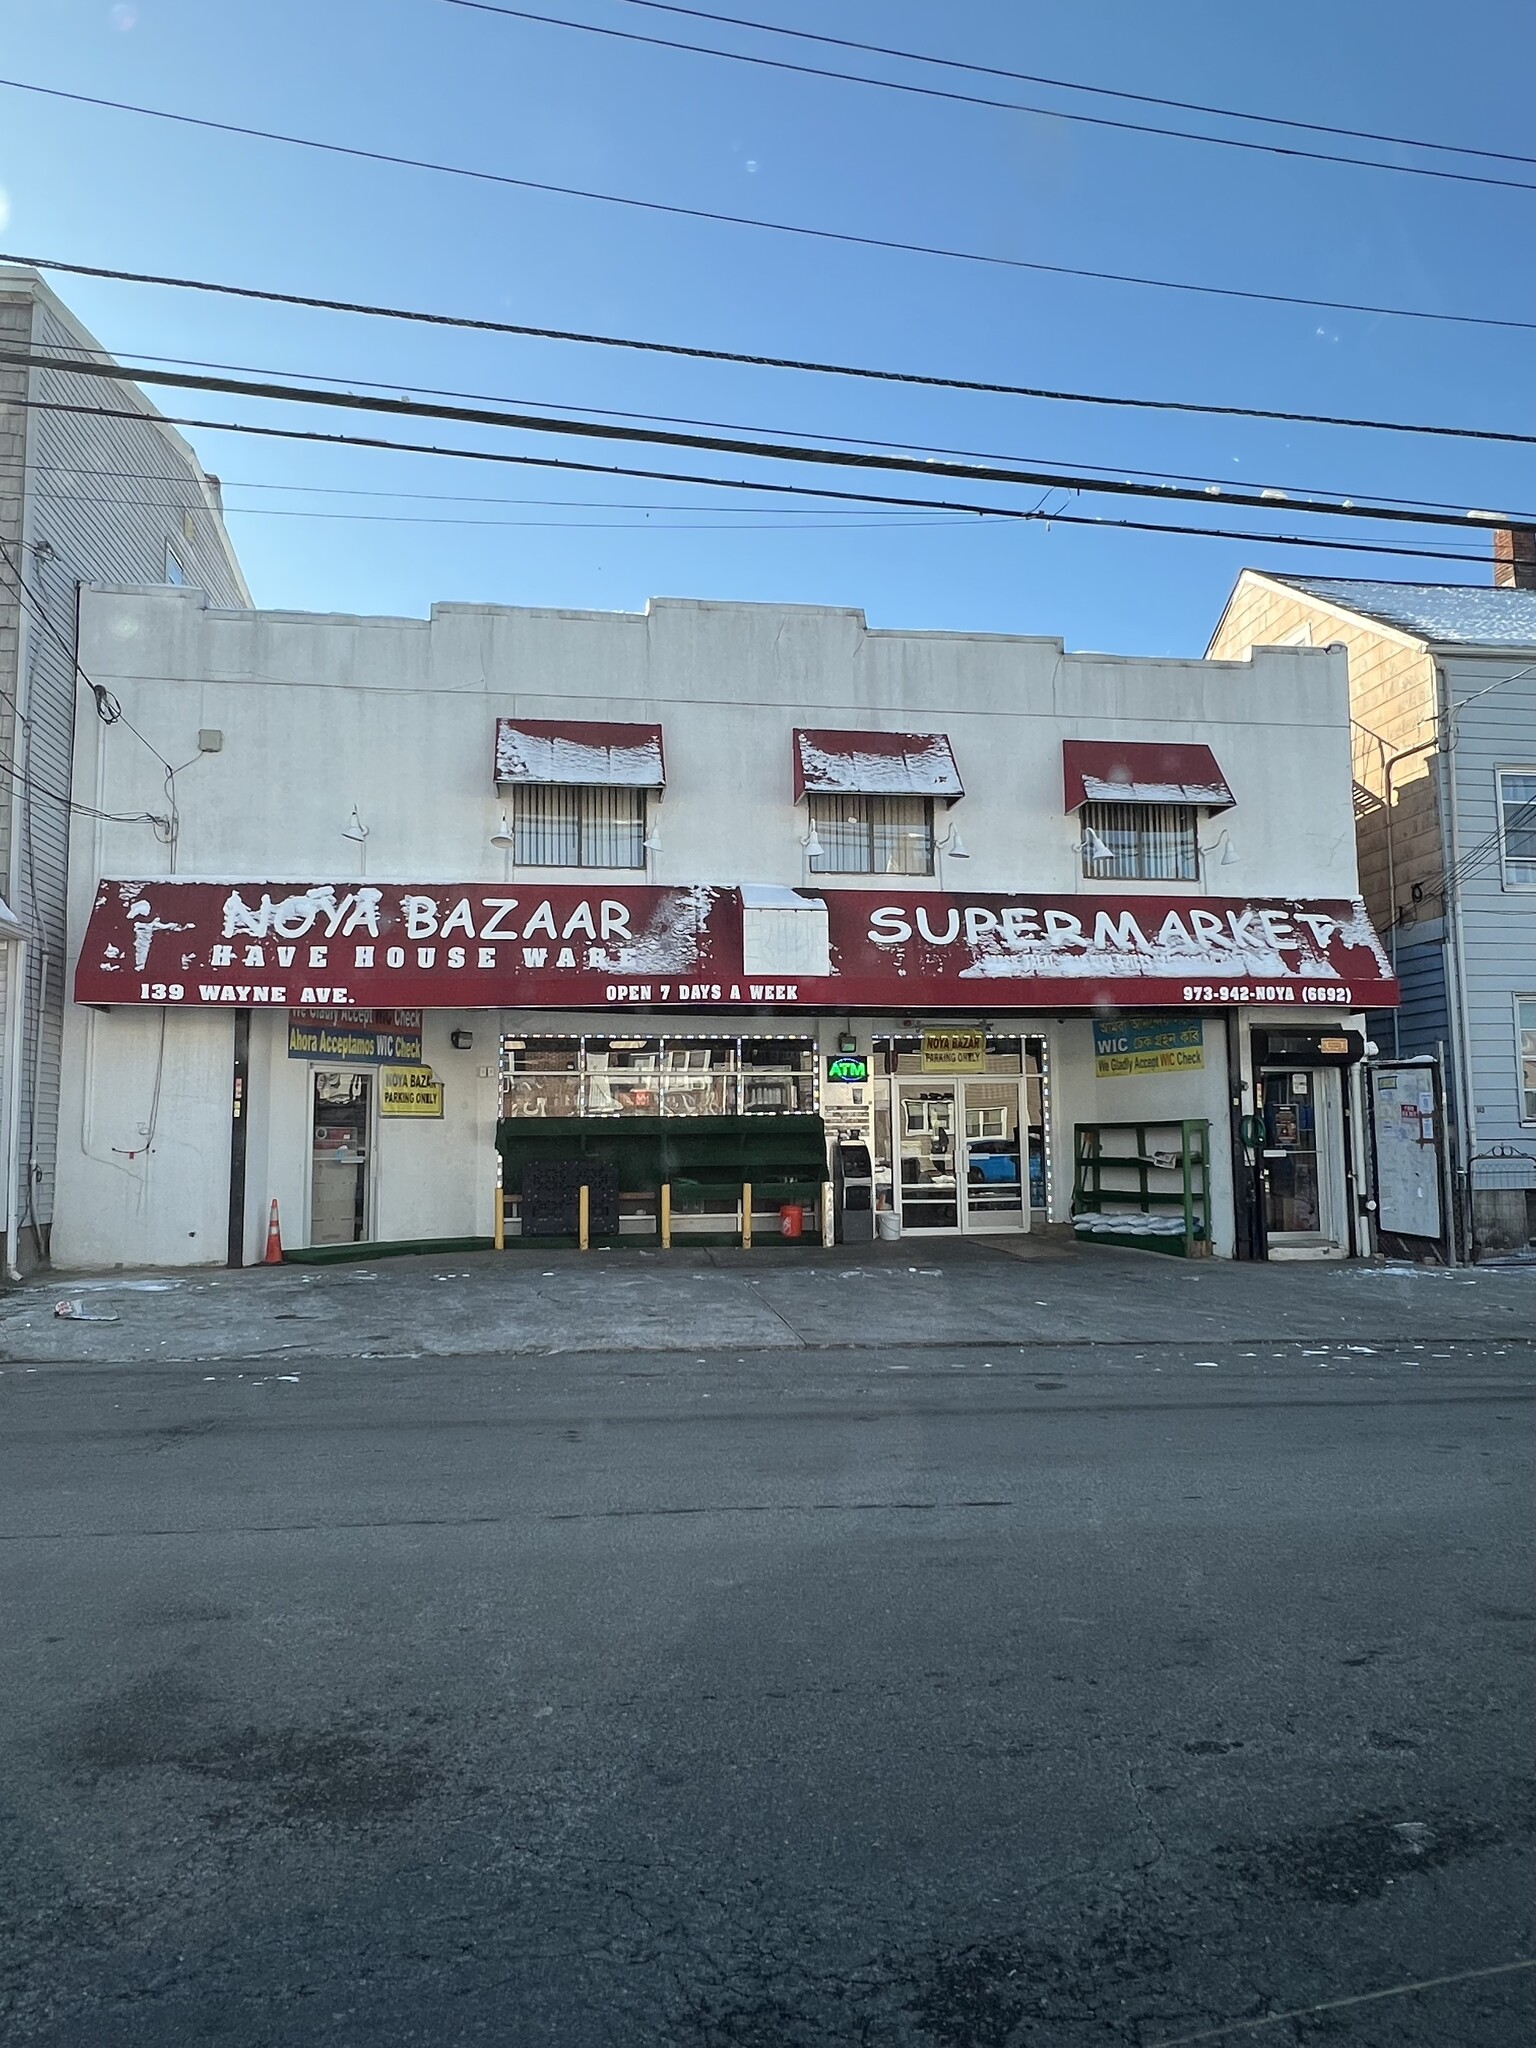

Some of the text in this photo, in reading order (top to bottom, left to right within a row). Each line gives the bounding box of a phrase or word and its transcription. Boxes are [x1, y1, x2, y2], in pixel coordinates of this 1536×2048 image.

[223, 886, 632, 940] NOYA BAZAAR
[867, 906, 1331, 951] SUPERMARKET
[211, 945, 328, 967] HAVE
[354, 946, 496, 968] HOUSE
[141, 984, 355, 1003] 139 WAYNE AVE.
[606, 984, 798, 1000] OPEN 7 DAYS A WEEK
[1183, 986, 1352, 1003] 973-942-NOYA (6692)
[289, 1028, 421, 1059] Ahora Acceptamos WIC Check
[927, 1037, 949, 1049] NOYA
[1098, 1037, 1128, 1054] WIC
[925, 1052, 956, 1063] PARKING
[1111, 1058, 1133, 1073] Gladly
[1160, 1052, 1175, 1067] WIC
[1177, 1051, 1201, 1066] Check
[829, 1062, 866, 1076] ATM
[385, 1073, 408, 1089] NOYA
[384, 1092, 414, 1104] PARKING
